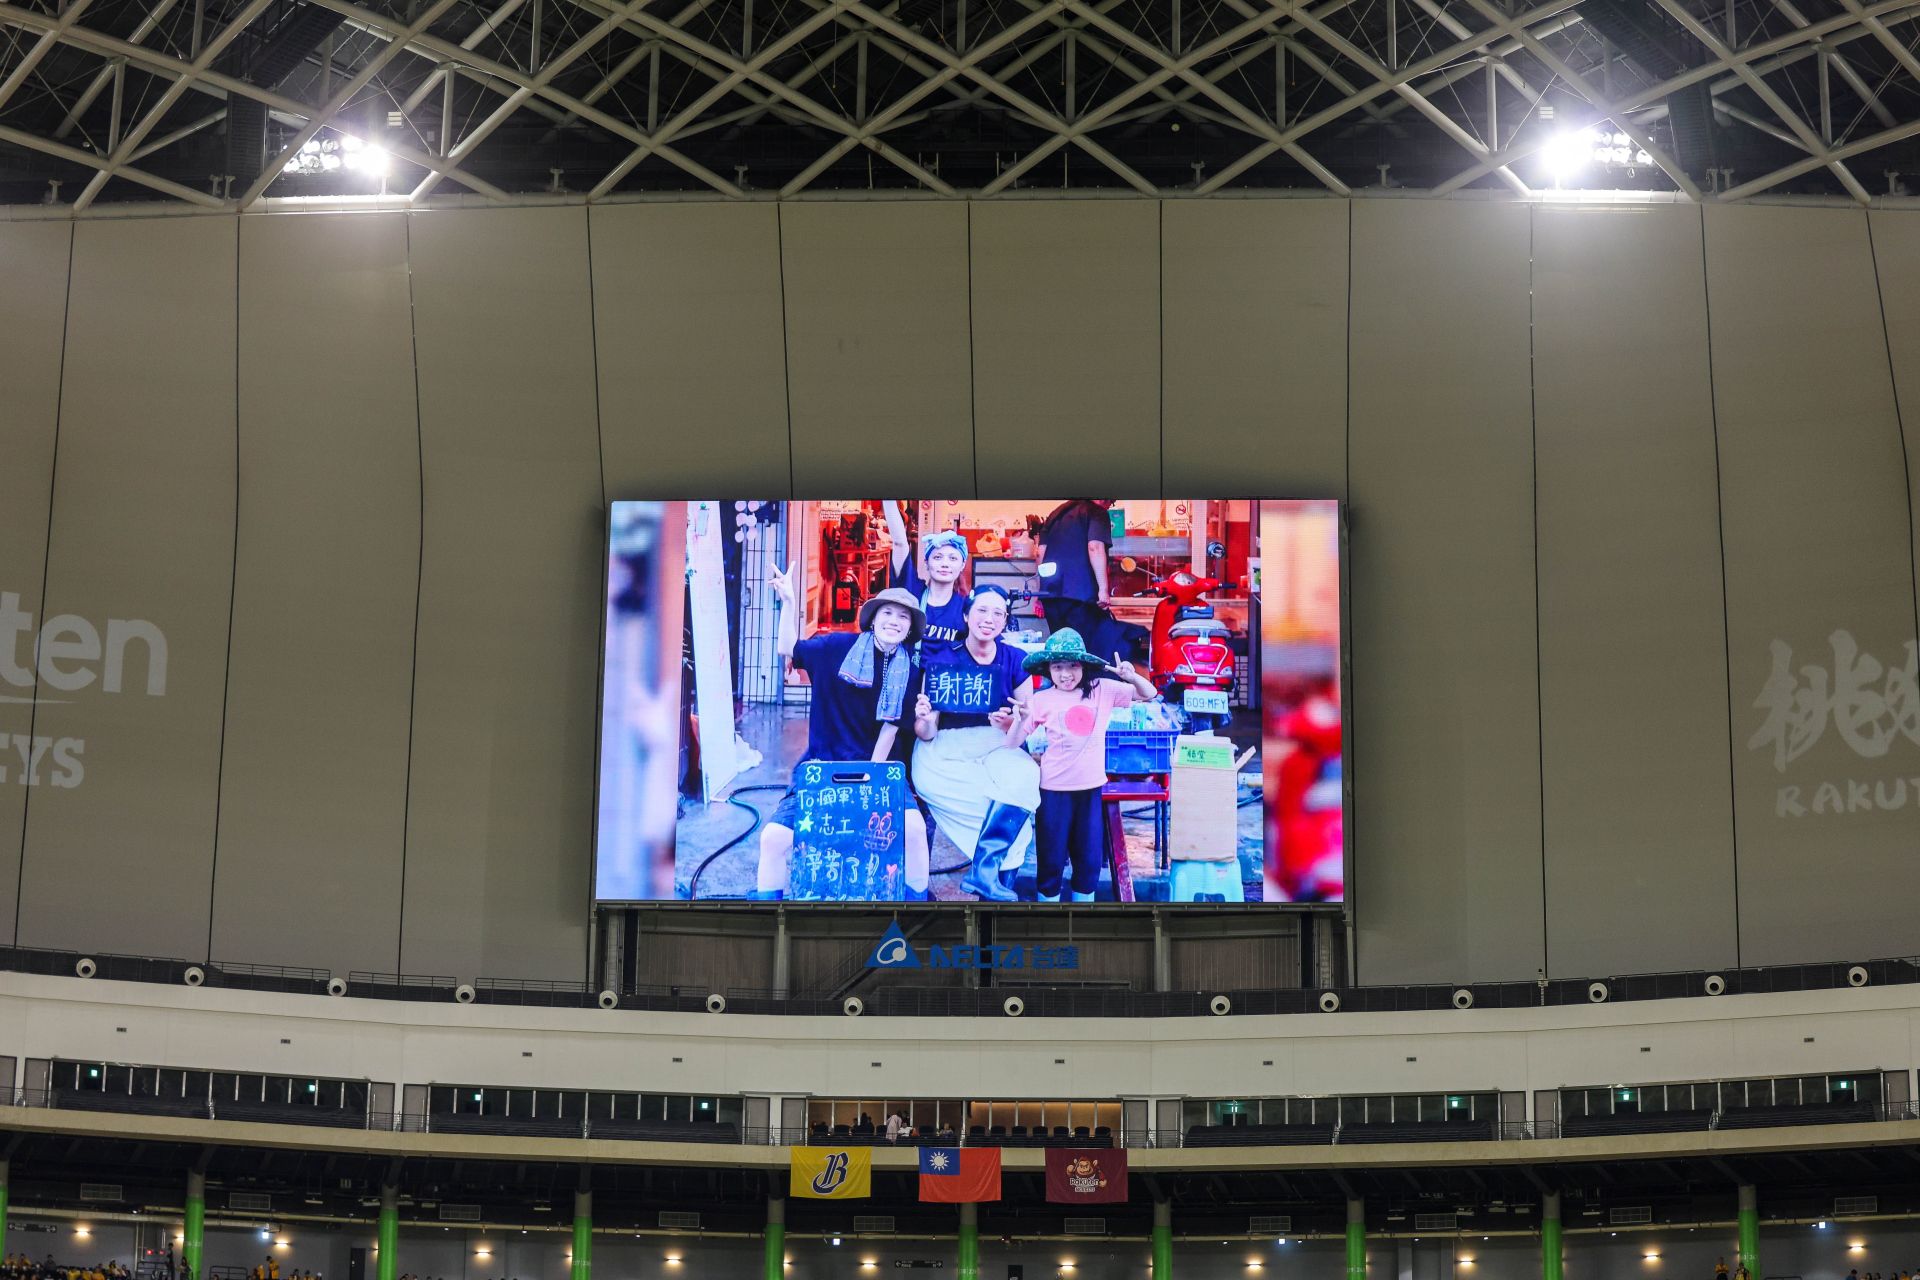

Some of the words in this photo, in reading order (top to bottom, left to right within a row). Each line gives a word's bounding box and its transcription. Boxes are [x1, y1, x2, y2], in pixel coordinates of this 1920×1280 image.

[929, 671, 993, 706] 謝謝
[819, 813, 855, 836] 志工
[930, 944, 1024, 969] DELTA
[1032, 945, 1080, 969] 台達
[811, 1152, 849, 1195] B
